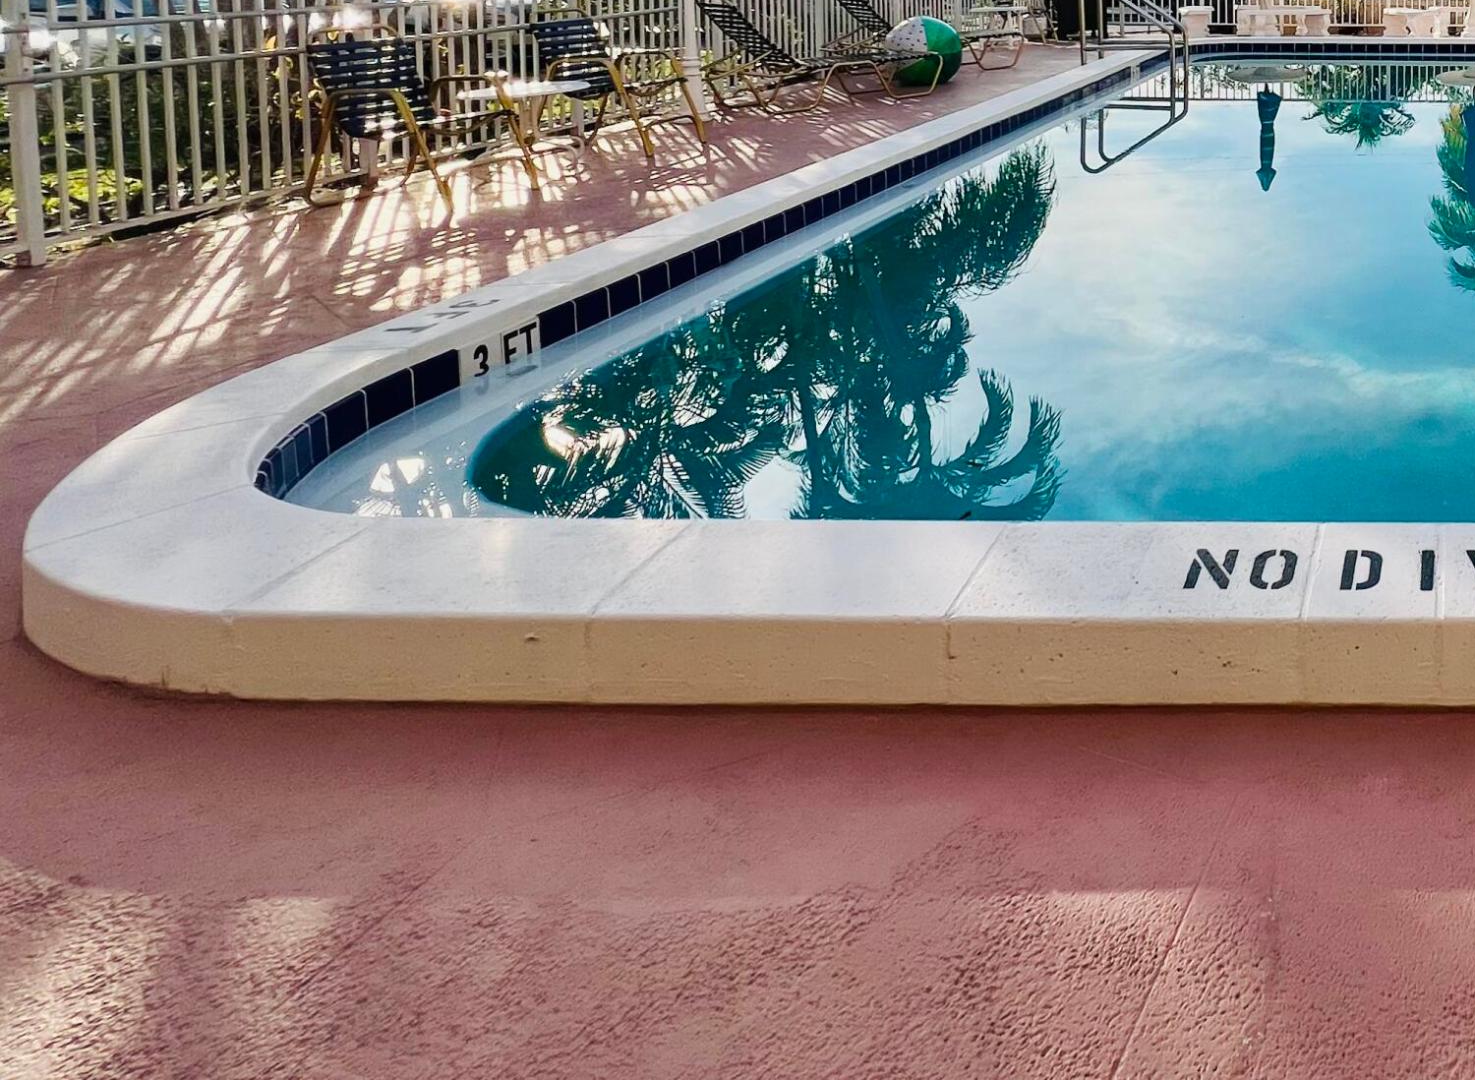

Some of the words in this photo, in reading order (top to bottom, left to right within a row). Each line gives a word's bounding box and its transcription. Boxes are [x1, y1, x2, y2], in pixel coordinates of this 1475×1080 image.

[473, 344, 490, 378] 3
[503, 321, 537, 365] FT
[1183, 548, 1298, 590] NO
